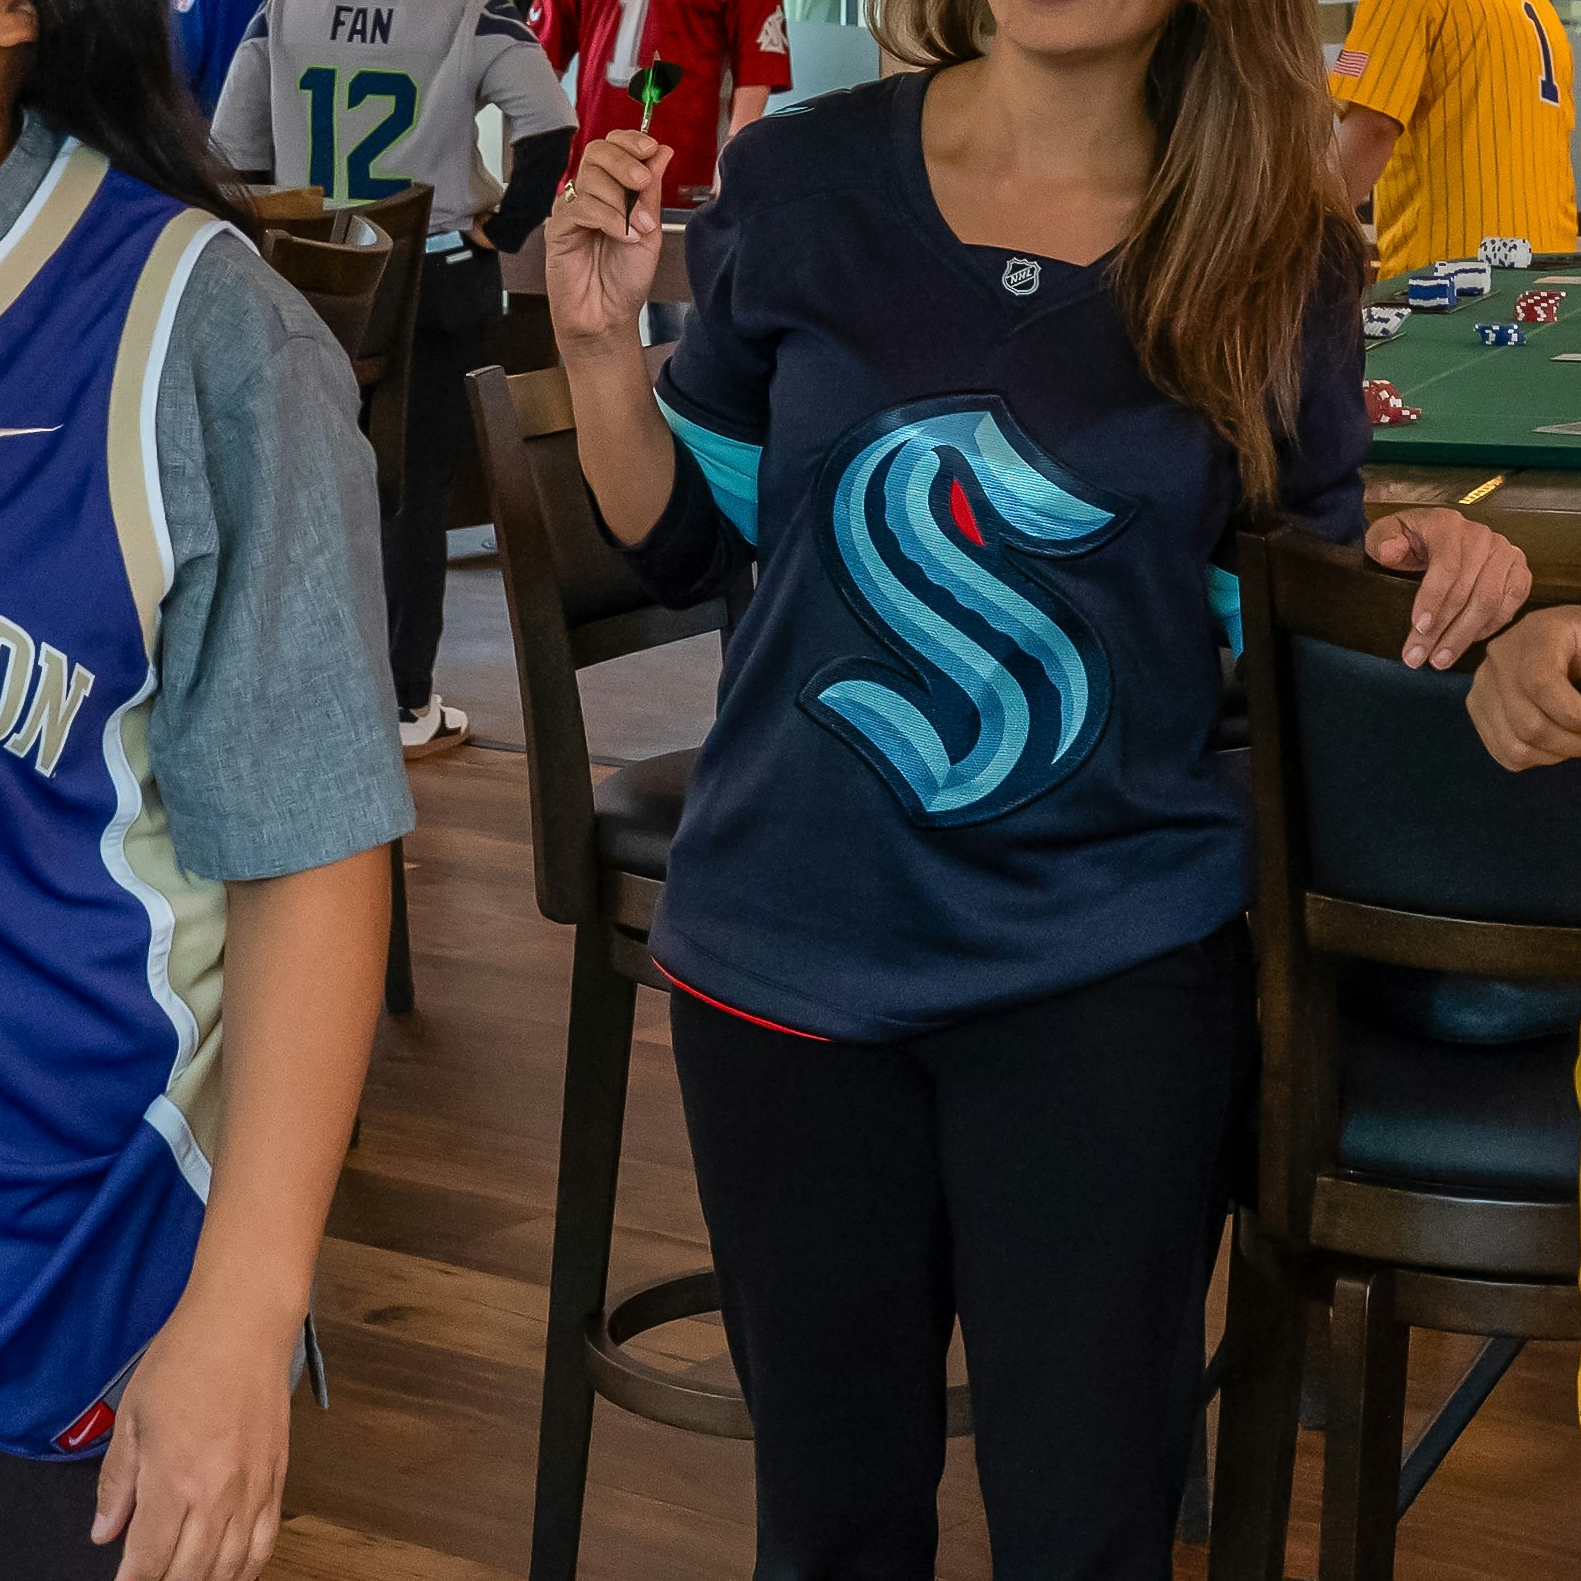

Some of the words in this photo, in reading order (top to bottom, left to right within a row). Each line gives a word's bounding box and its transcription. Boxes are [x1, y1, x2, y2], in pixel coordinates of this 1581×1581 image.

[330, 4, 394, 45] FAN
[298, 65, 419, 202] 12
[1010, 267, 1033, 285] NHL
